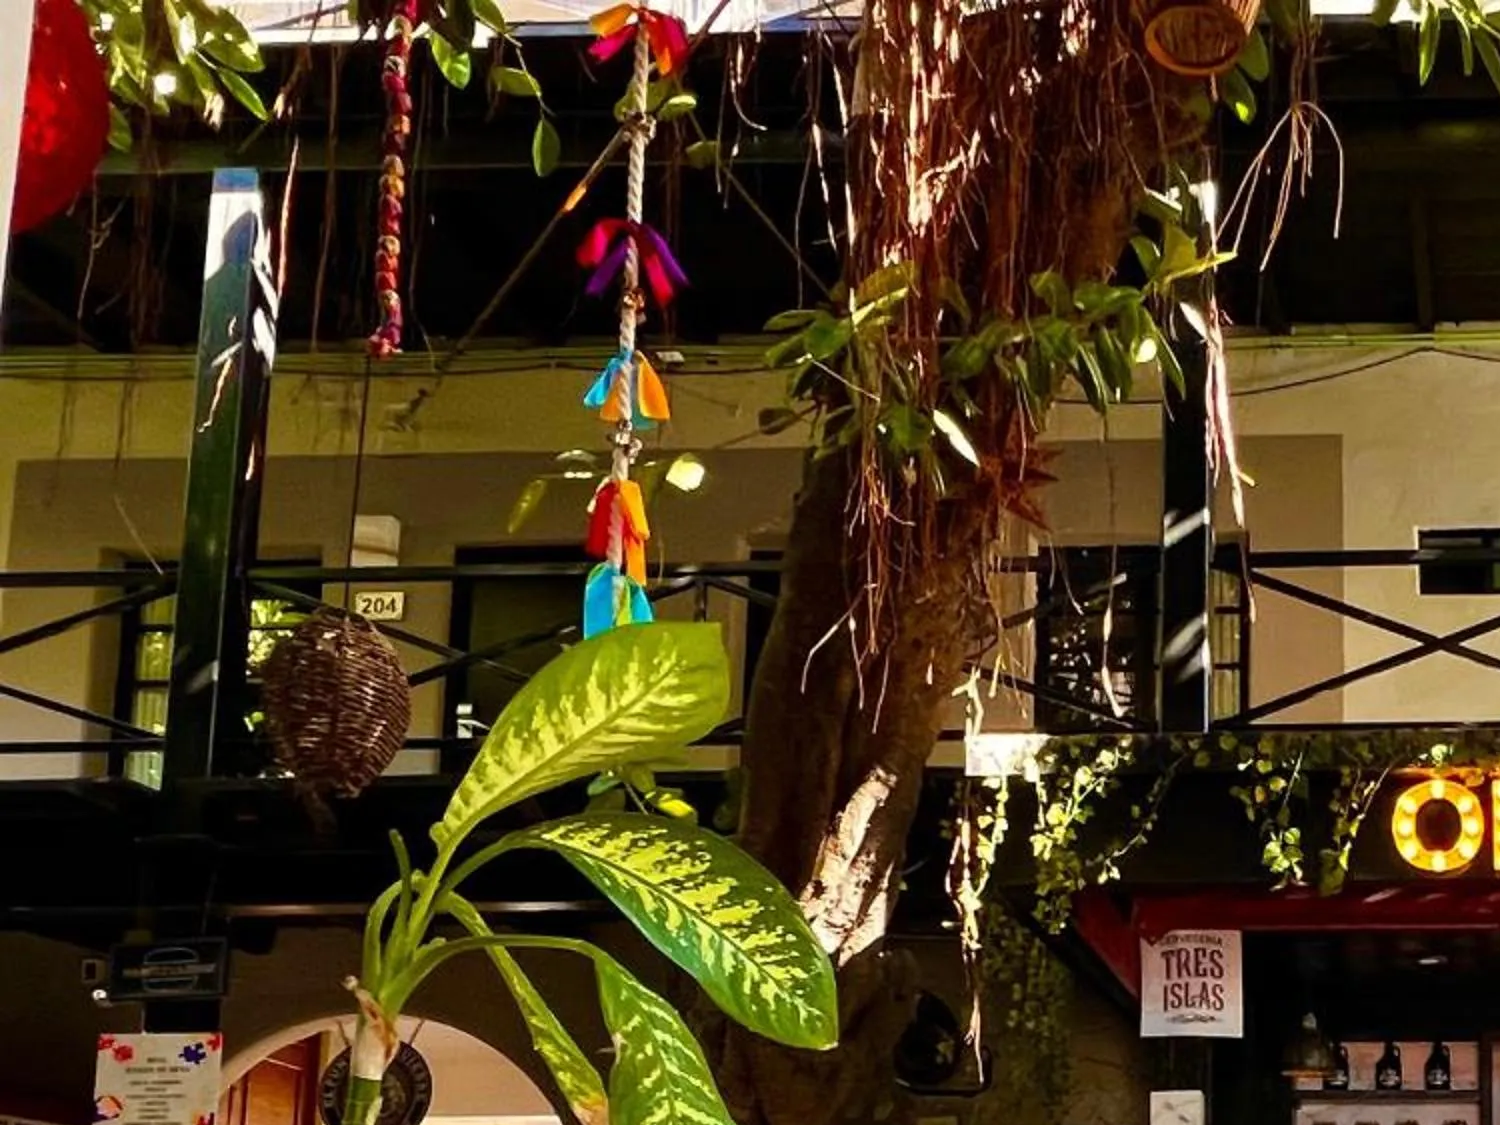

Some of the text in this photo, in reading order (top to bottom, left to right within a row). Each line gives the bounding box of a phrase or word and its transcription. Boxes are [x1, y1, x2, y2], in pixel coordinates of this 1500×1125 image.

[362, 597, 397, 614] 204
[1160, 947, 1225, 981] TRES
[1163, 981, 1225, 1013] ISLAS
